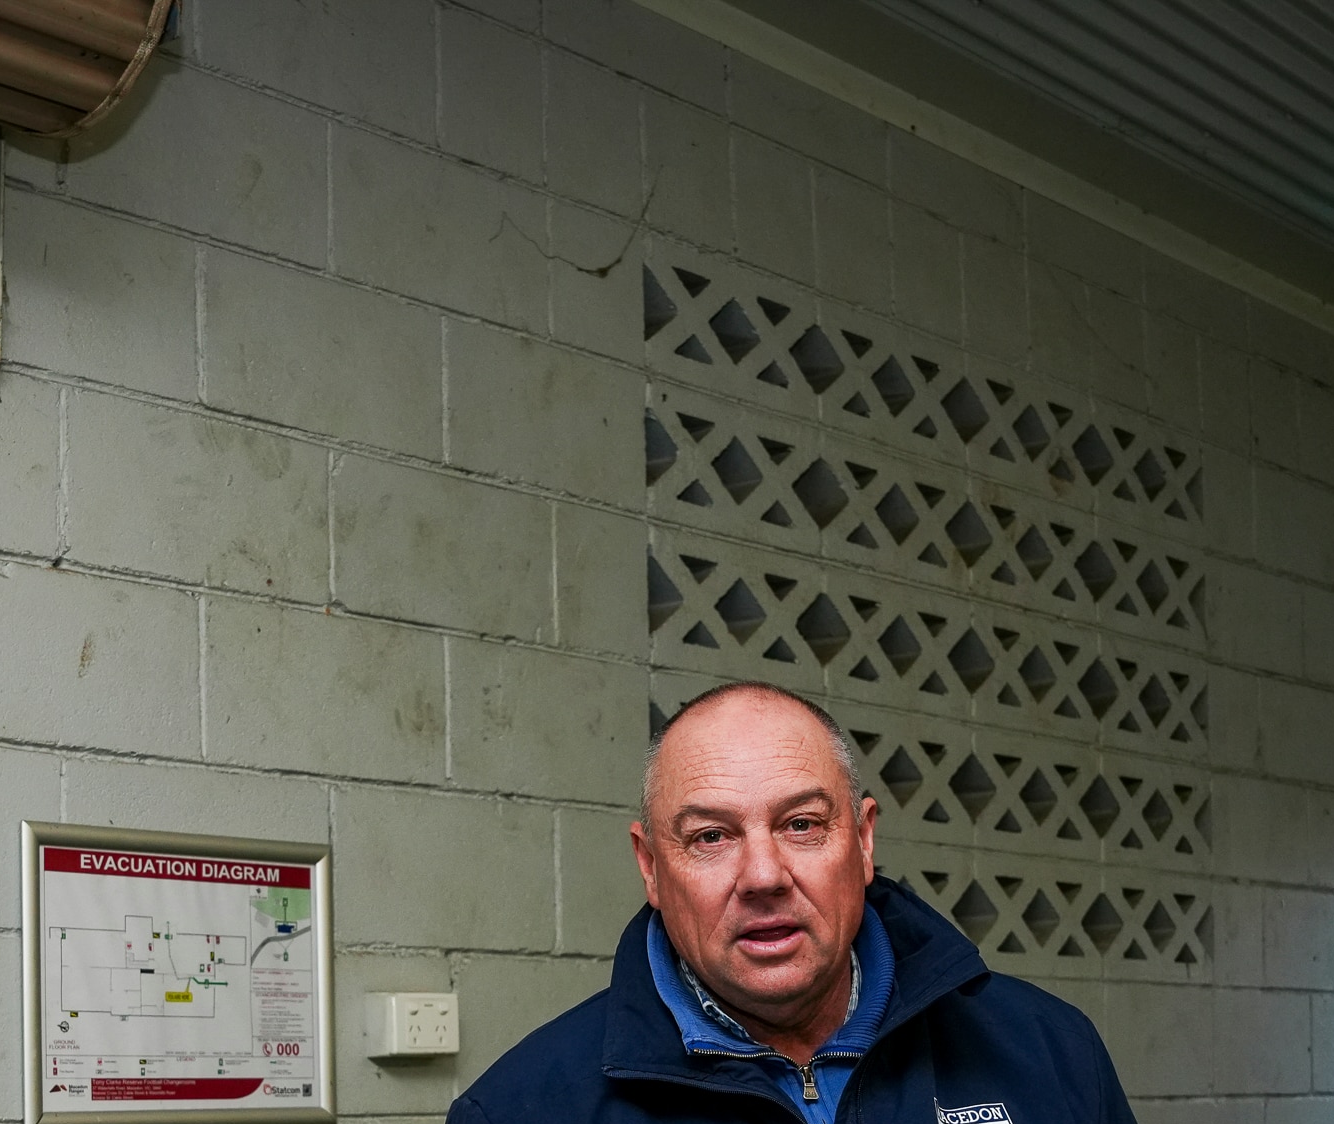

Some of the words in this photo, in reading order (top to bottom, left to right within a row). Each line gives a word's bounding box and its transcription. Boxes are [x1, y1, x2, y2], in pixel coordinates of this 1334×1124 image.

[80, 854, 197, 877] EVACUATION
[201, 863, 280, 883] DIAGRAM
[276, 1043, 300, 1056] 000
[271, 1086, 301, 1094] Statcom
